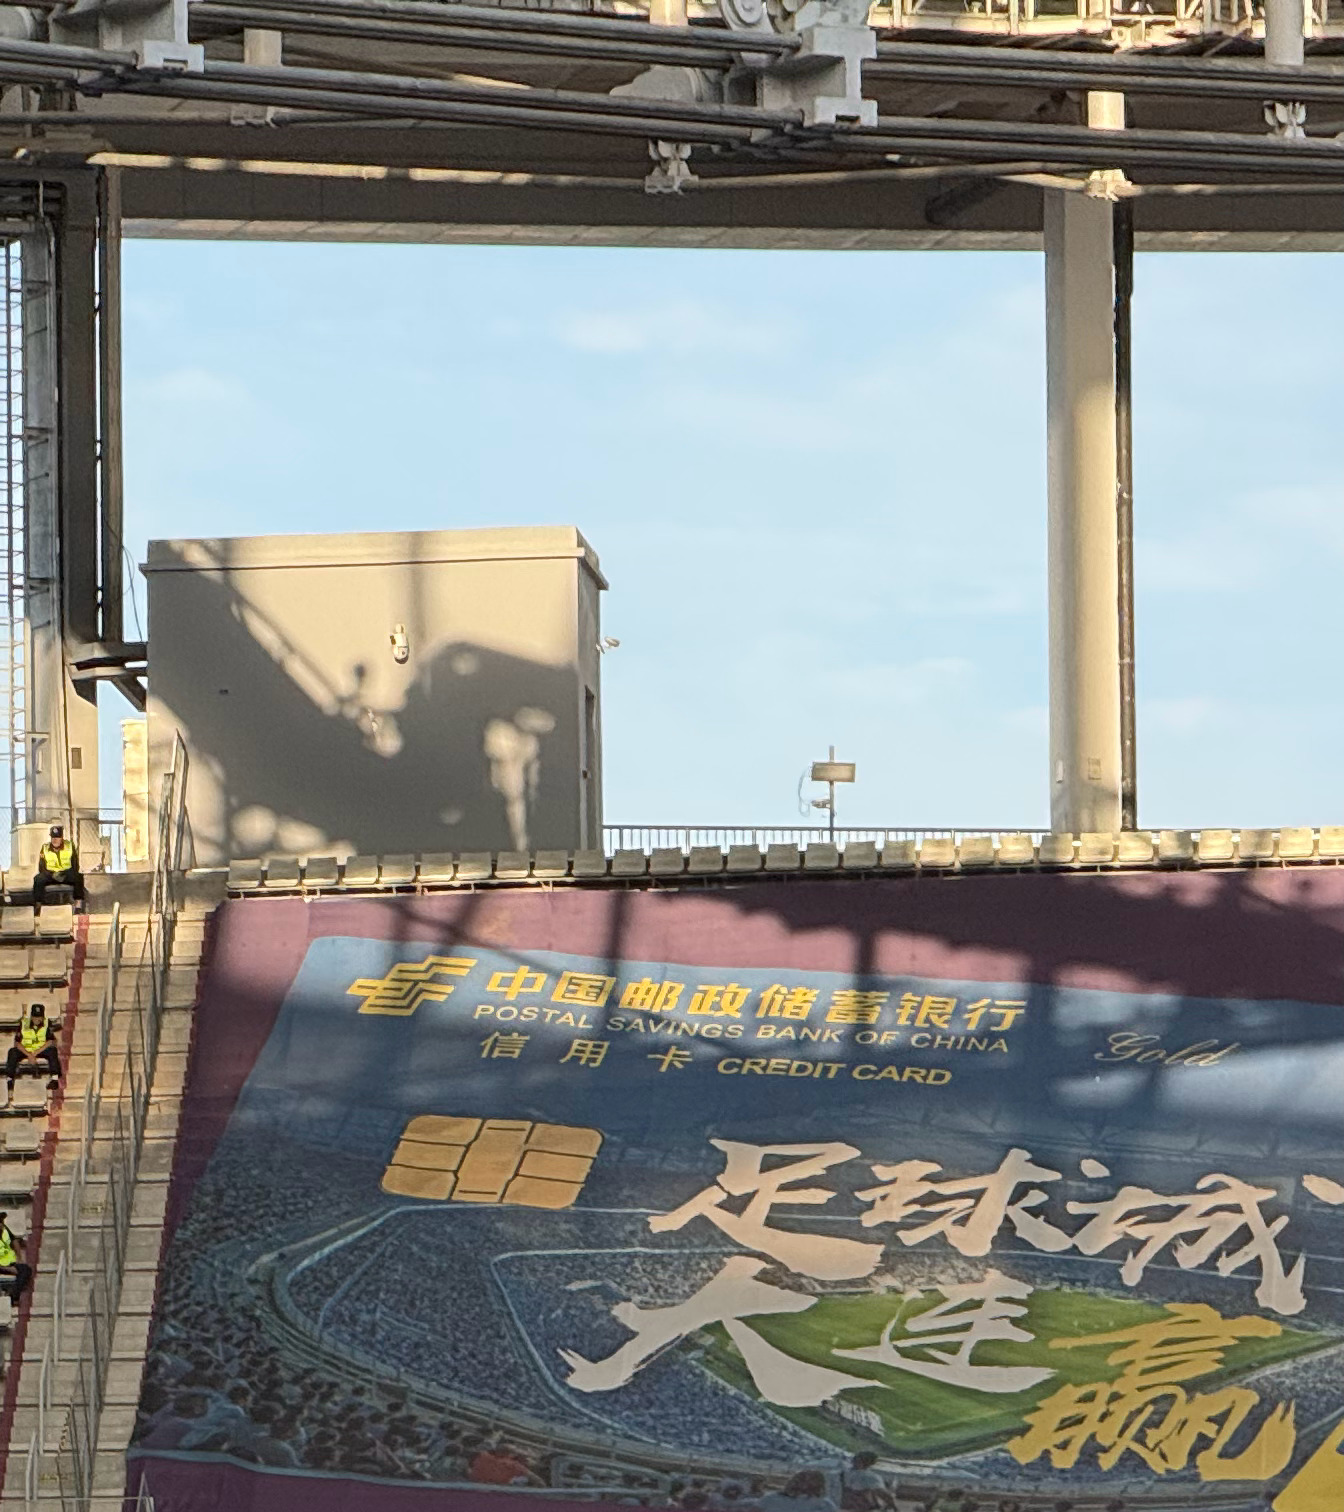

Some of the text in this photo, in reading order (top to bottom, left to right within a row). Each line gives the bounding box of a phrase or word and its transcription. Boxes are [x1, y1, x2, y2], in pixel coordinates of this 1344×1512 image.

[485, 965, 1028, 1032] 中国邮政储蓄银行
[472, 1004, 1009, 1053] POSTAL SAVINGS BANK OF CHINA
[1094, 1031, 1241, 1067] Gold
[479, 1032, 953, 1086] 信用卡 CREDIT CARD
[648, 1138, 1344, 1316] 足球城
